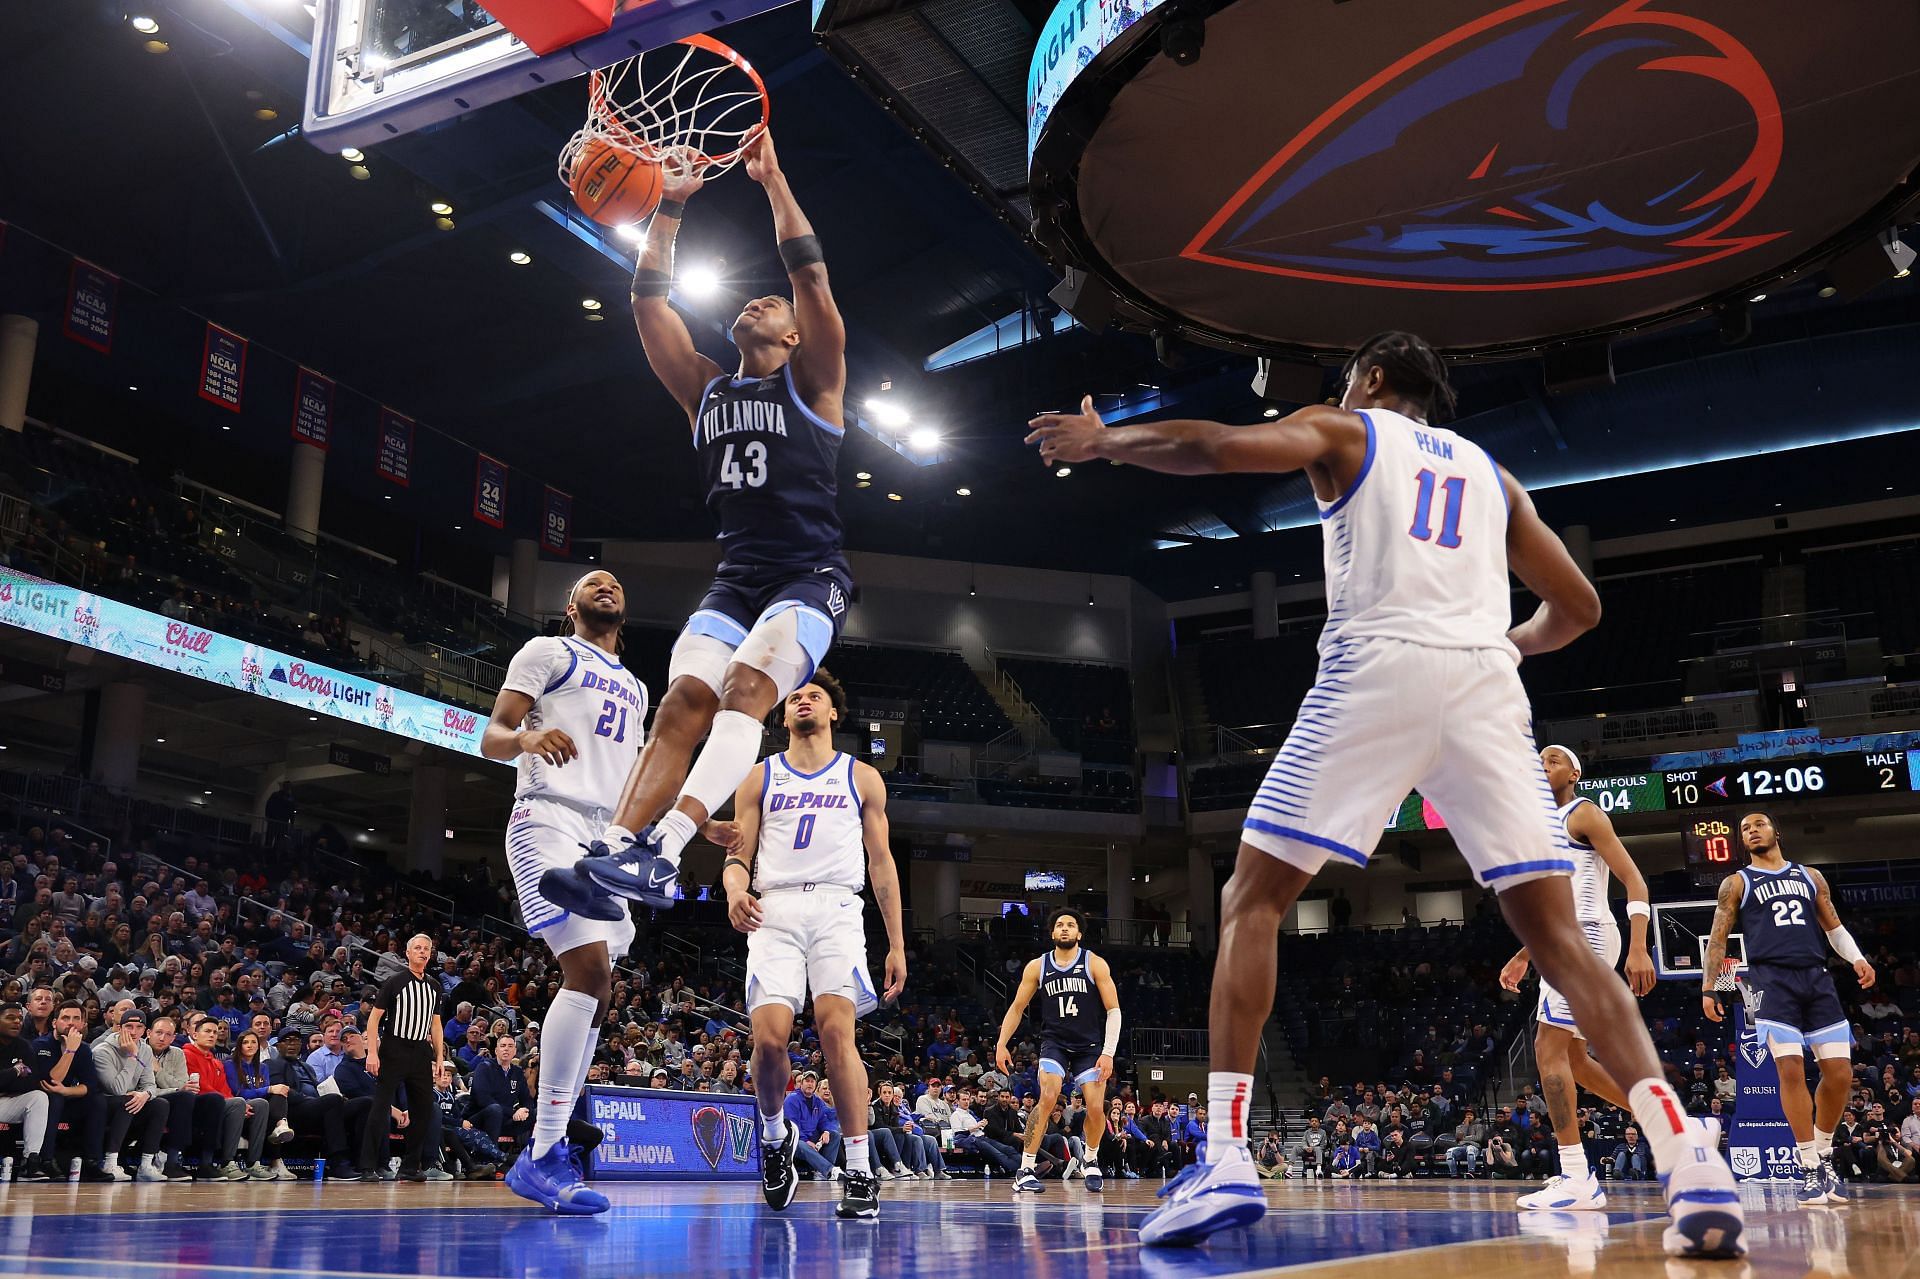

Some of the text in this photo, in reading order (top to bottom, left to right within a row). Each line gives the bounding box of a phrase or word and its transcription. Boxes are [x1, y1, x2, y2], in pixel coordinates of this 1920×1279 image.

[76, 290, 107, 313] NCAA
[210, 353, 237, 373] NCAA
[303, 395, 327, 413] NCAA
[703, 400, 789, 445] VILLANOVA
[384, 434, 406, 450] NCAA
[1414, 430, 1454, 461] PENN
[720, 440, 768, 490] 43
[482, 481, 500, 503] 24
[1408, 467, 1467, 550] 11
[548, 512, 566, 532] 99
[15, 591, 69, 618] LIGHT
[165, 621, 213, 655] Chill
[1729, 658, 1750, 671] 202
[42, 673, 63, 690] 125
[289, 660, 372, 708] Coors LIGHT
[443, 707, 478, 735] Chill
[594, 699, 628, 744] 21
[1866, 752, 1904, 767] HALF
[1577, 776, 1647, 791] TEAM FOULS
[1666, 771, 1698, 783] SHOT
[1736, 765, 1824, 796] 12:06
[1879, 767, 1896, 789] 2
[1599, 789, 1631, 812] 04
[1671, 784, 1699, 805] 10
[792, 813, 817, 850] 0
[1694, 820, 1730, 837] 12:06
[912, 848, 928, 858] 127
[953, 852, 969, 861] 128
[1705, 836, 1730, 862] 10
[1753, 879, 1812, 905] VILLANOVA
[1771, 900, 1807, 927] 22
[1044, 977, 1088, 997] VILLANOVA
[1058, 995, 1079, 1018] 14
[1752, 1086, 1777, 1095] RUSH
[596, 1143, 676, 1164] VILLANOVA
